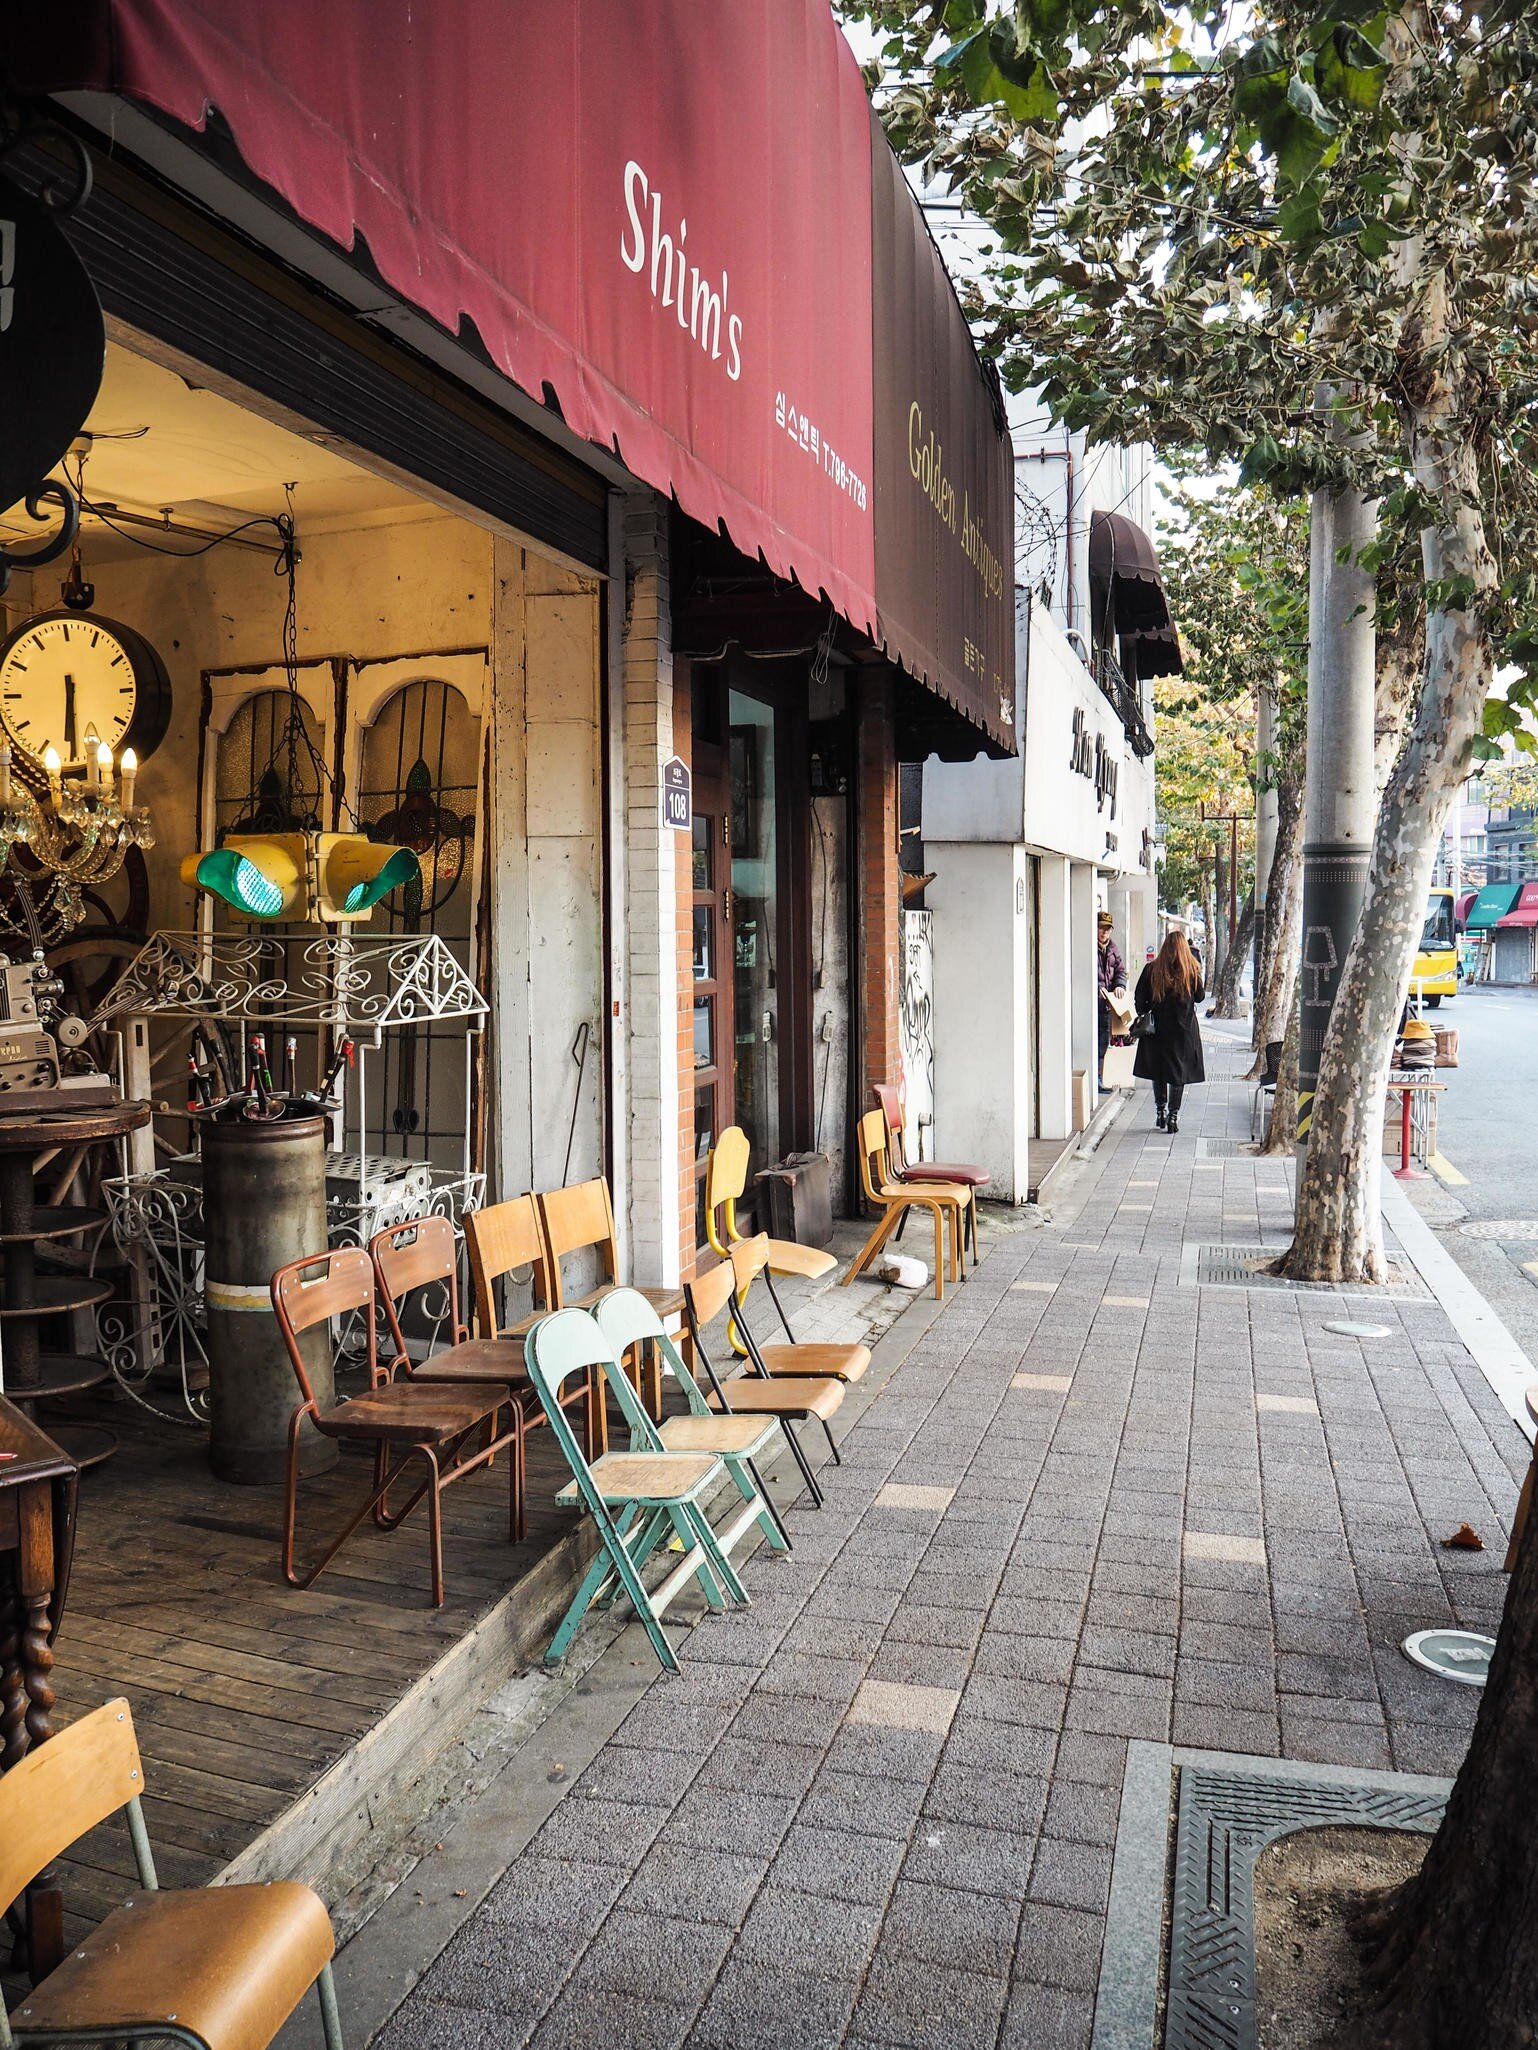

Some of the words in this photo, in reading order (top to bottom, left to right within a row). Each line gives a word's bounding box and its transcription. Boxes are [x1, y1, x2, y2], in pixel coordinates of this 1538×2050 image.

[620, 160, 742, 381] Shim's
[775, 391, 819, 464] 심스앤틱
[907, 400, 957, 535] Golden
[960, 489, 1004, 601] Antiques
[668, 793, 687, 820] 108
